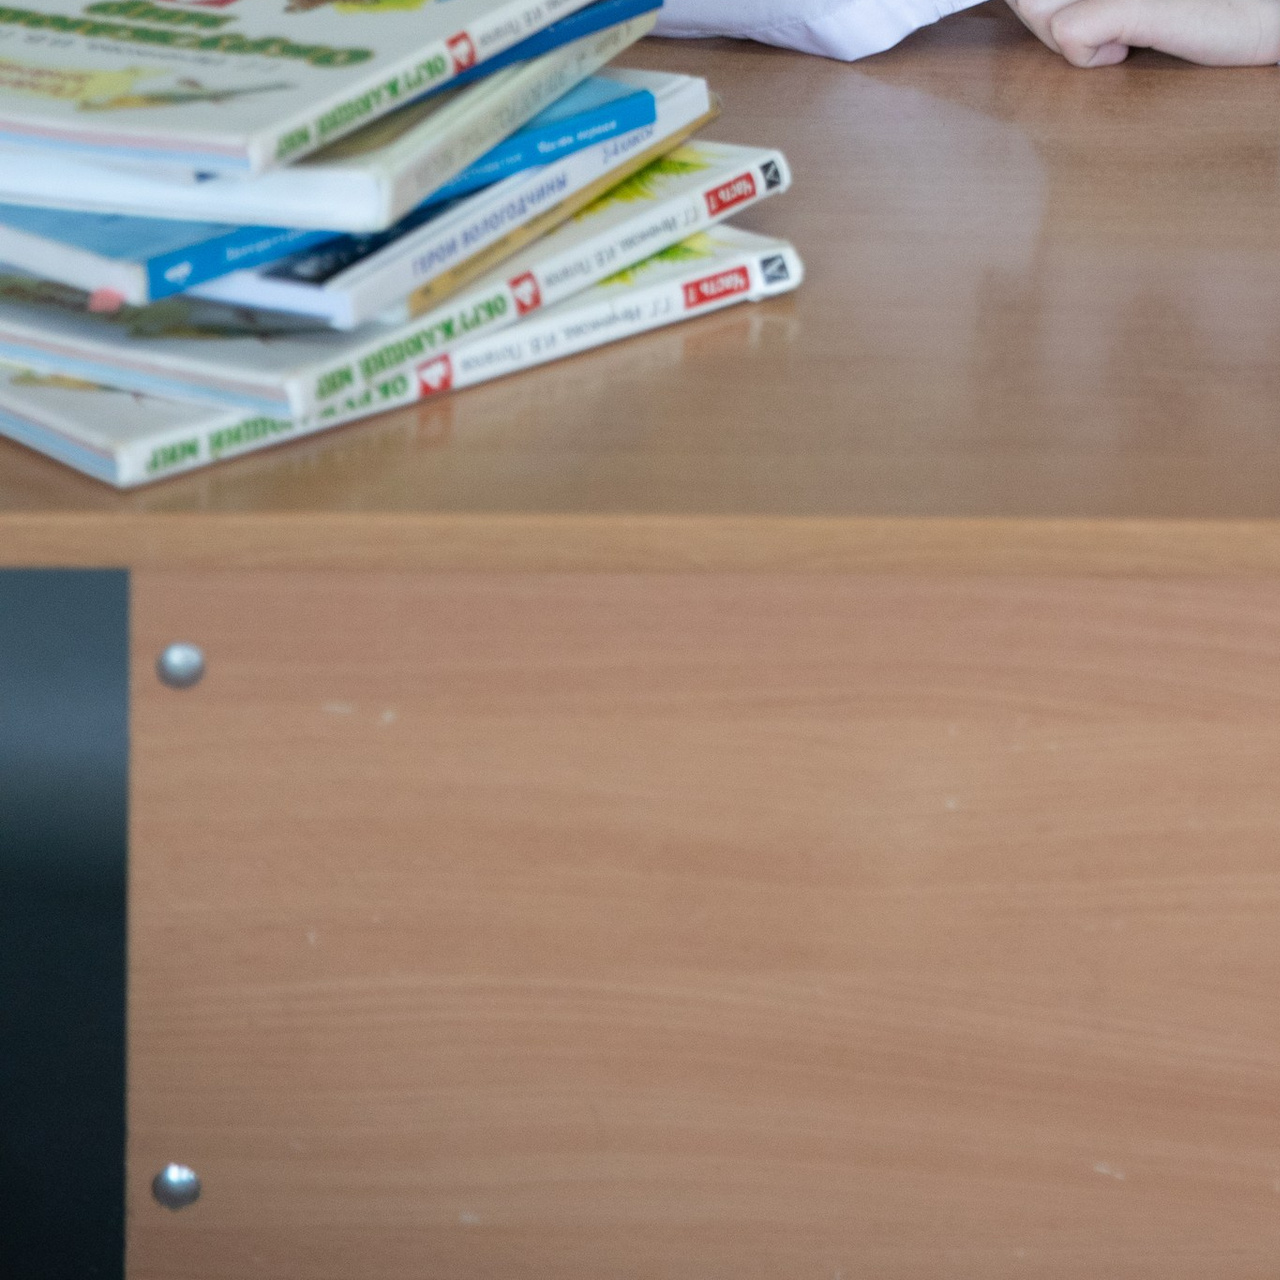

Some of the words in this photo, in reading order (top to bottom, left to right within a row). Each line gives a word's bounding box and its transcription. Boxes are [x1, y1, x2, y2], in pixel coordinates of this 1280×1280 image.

[714, 175, 755, 203] Часть
[700, 274, 747, 295] Часть
[357, 292, 509, 383] ОКРУЖАЮЩИЙ
[314, 365, 354, 401] МИР
[145, 438, 200, 473] МИР
